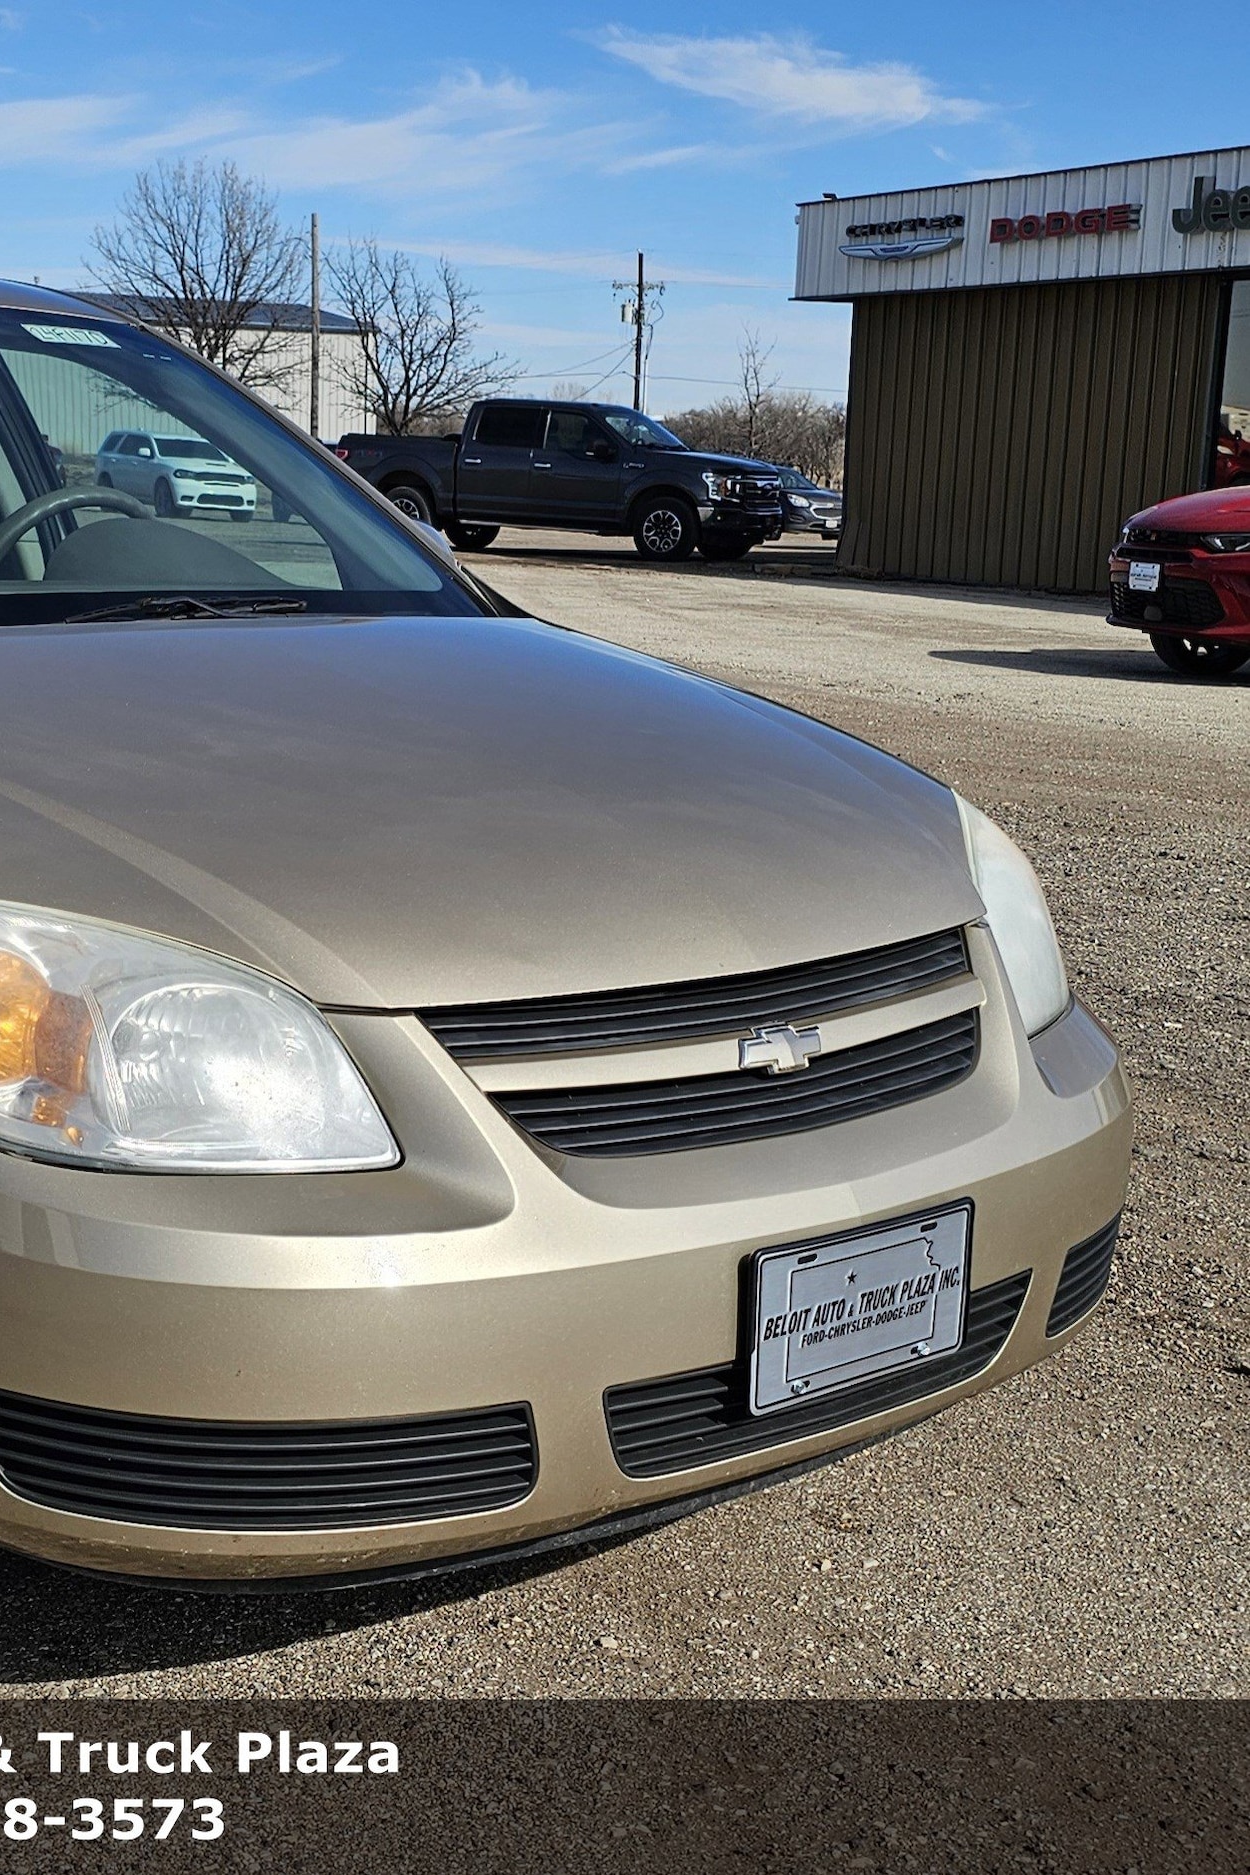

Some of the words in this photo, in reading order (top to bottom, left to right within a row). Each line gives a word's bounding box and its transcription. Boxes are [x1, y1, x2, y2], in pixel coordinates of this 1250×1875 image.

[846, 214, 964, 237] CHRYSLER
[989, 204, 1142, 244] DODGE
[763, 1308, 812, 1341] BELOIT
[812, 1298, 846, 1328] AUTO
[847, 1303, 854, 1318] &
[858, 1283, 899, 1314] TRUCK
[899, 1273, 937, 1302] PLAZA
[938, 1266, 960, 1292] INC.
